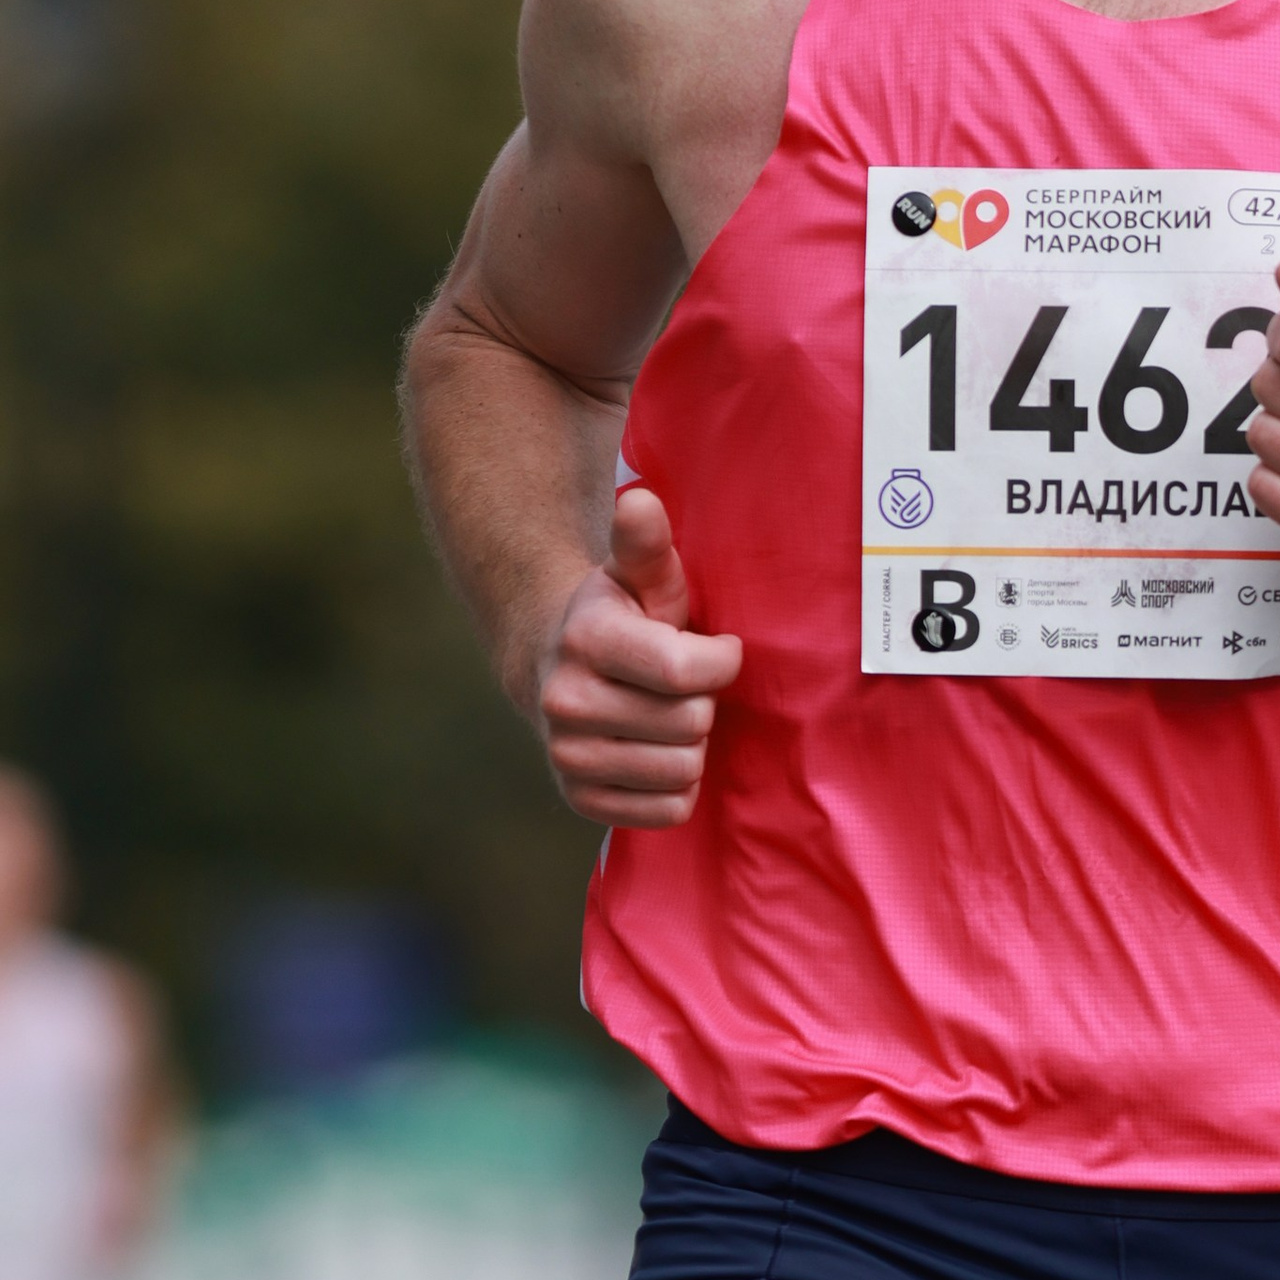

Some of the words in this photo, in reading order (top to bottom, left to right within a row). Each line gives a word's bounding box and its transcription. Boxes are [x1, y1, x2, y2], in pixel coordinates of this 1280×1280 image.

[1025, 187, 1163, 204] СБЕРПРАЙМ
[896, 197, 931, 230] RUN
[1024, 206, 1211, 230] МОСКОВСКИЙ
[1024, 234, 1162, 254] МАРАФОН
[1006, 479, 1266, 523] ВЛАДИСЛА
[1141, 577, 1214, 594] МОСКОВСКИЙ
[1141, 595, 1175, 608] СПОРТ
[1061, 638, 1098, 649] BRICS
[1134, 636, 1203, 647] магнит
[1246, 636, 1266, 647] сбп
